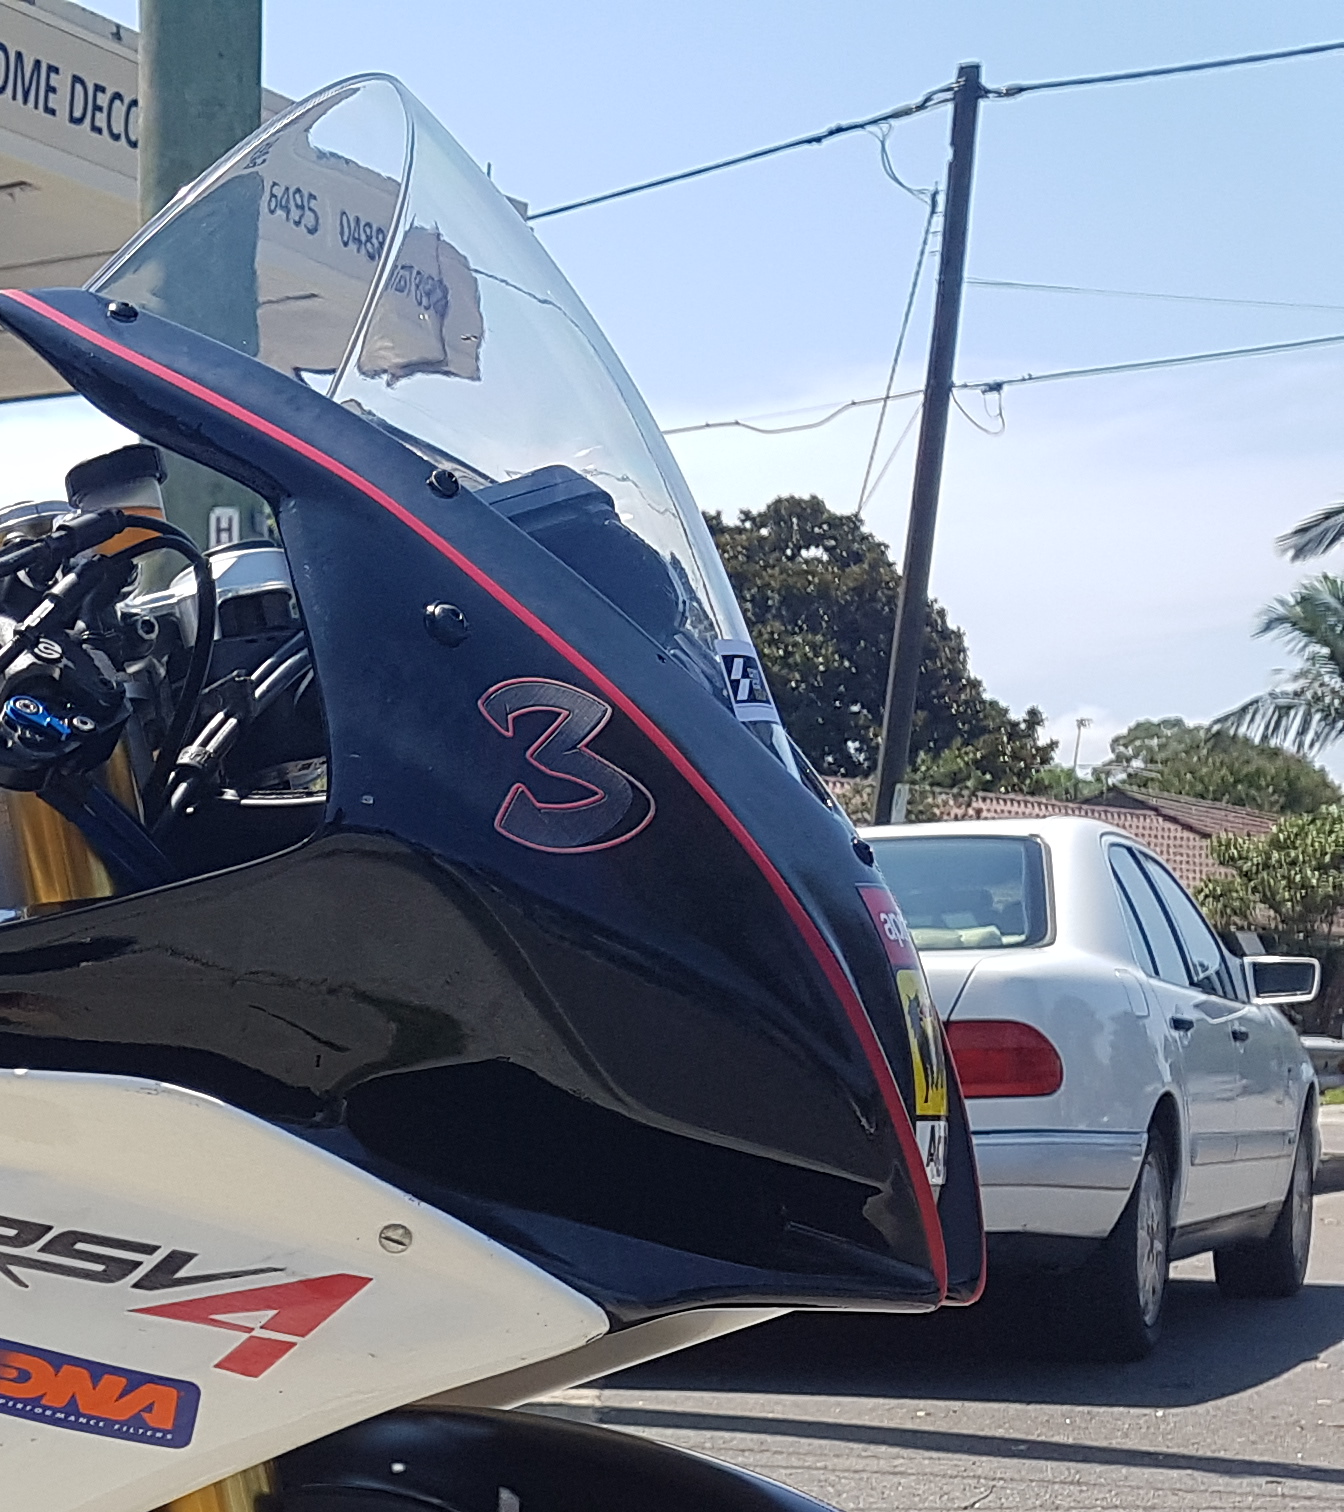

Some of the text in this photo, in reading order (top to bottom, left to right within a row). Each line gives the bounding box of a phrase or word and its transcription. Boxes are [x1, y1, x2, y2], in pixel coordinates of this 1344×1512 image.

[268, 180, 320, 236] 6495
[478, 677, 655, 853] 3
[113, 1424, 173, 1440] FILTERS
